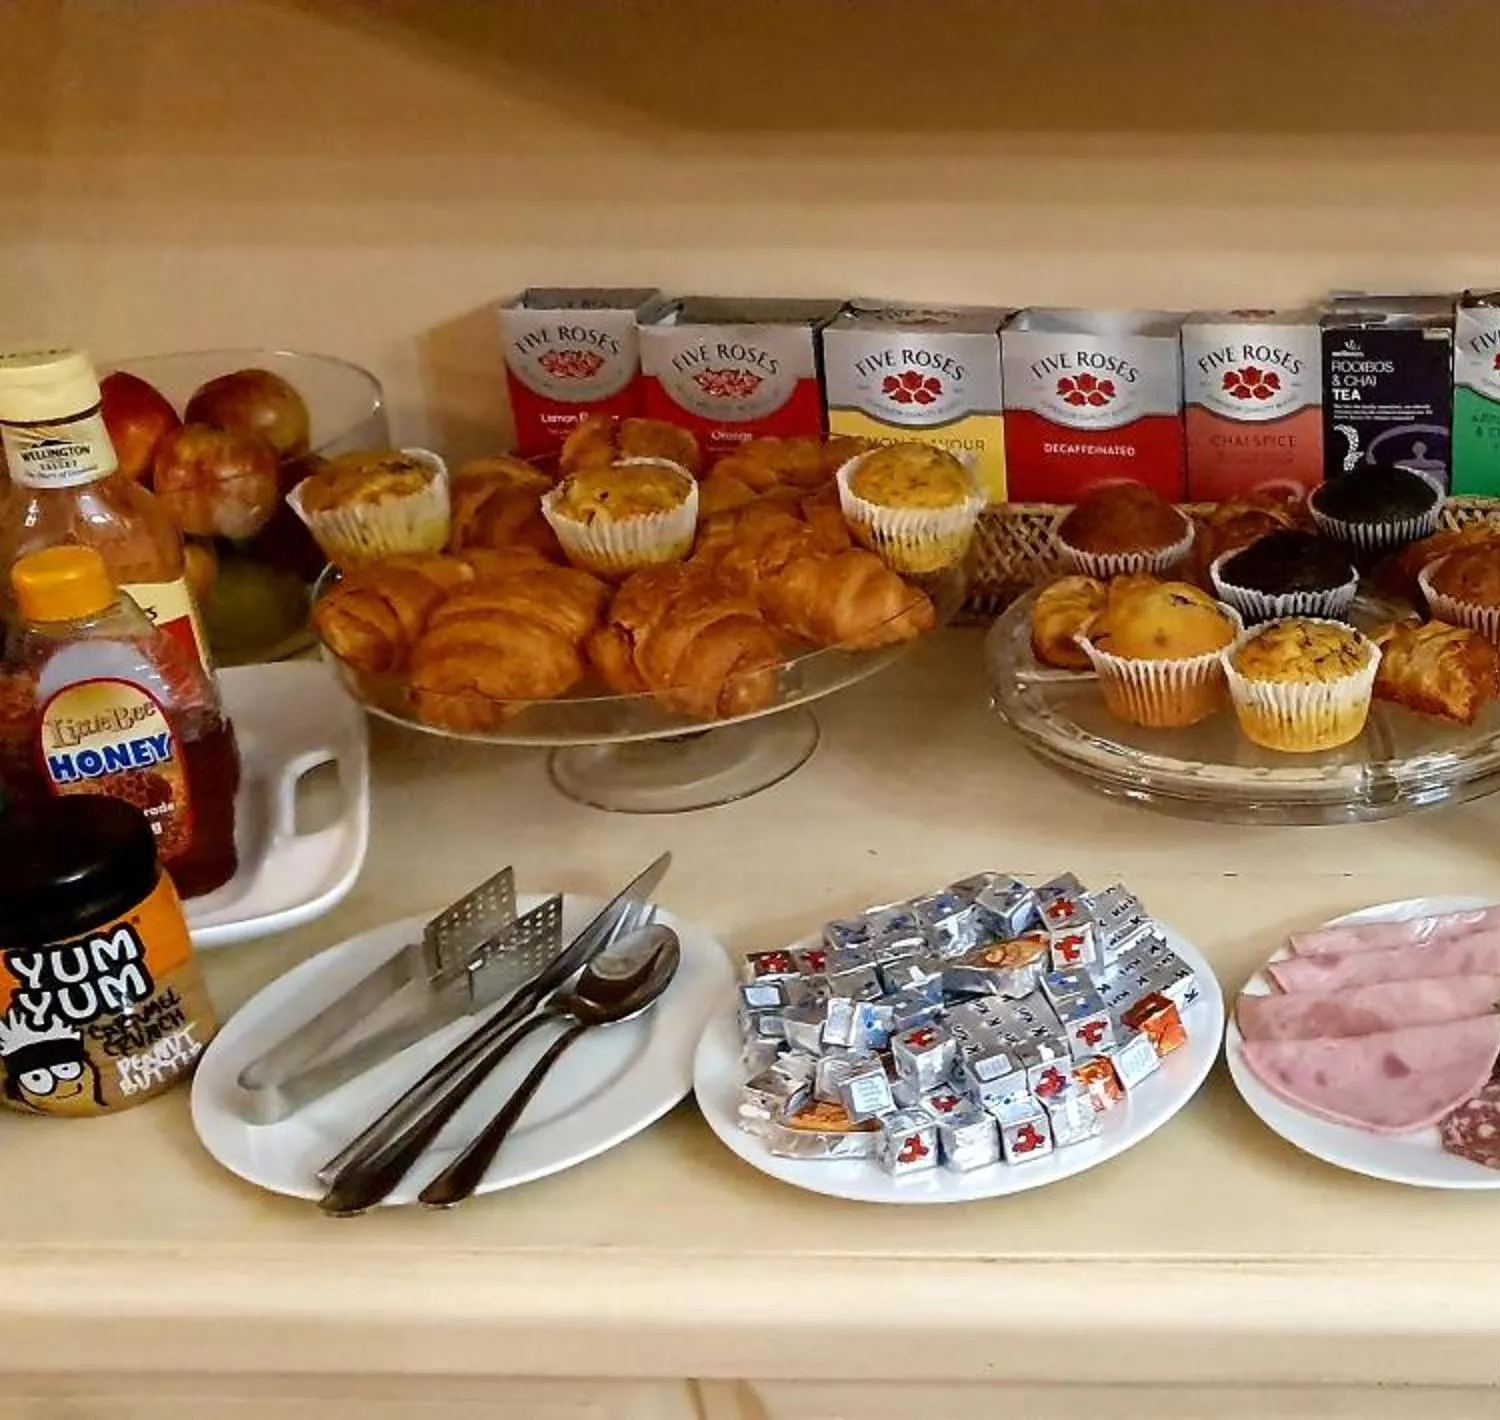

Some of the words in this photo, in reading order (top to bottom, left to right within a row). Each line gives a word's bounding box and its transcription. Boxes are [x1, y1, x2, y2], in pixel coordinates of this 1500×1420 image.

[512, 326, 552, 356] FIVE
[558, 325, 622, 356] ROSES
[671, 344, 711, 373] FIVE
[717, 342, 780, 376] ROSES
[854, 350, 897, 378] FIVE
[902, 349, 965, 381] ROSES
[1030, 352, 1072, 379] FIVE
[1077, 351, 1140, 383] ROSES
[1197, 346, 1235, 375] FIVE
[1243, 345, 1303, 375] ROSES
[1331, 361, 1395, 373] ROOIBOS
[1331, 374, 1340, 387] &
[1331, 388, 1361, 401] TEA
[21, 445, 91, 461] WELLINGTON
[1043, 443, 1136, 457] DECAFFEINATED
[48, 732, 168, 782] HONEY
[11, 928, 138, 989] YUM
[19, 963, 148, 1026] YUM
